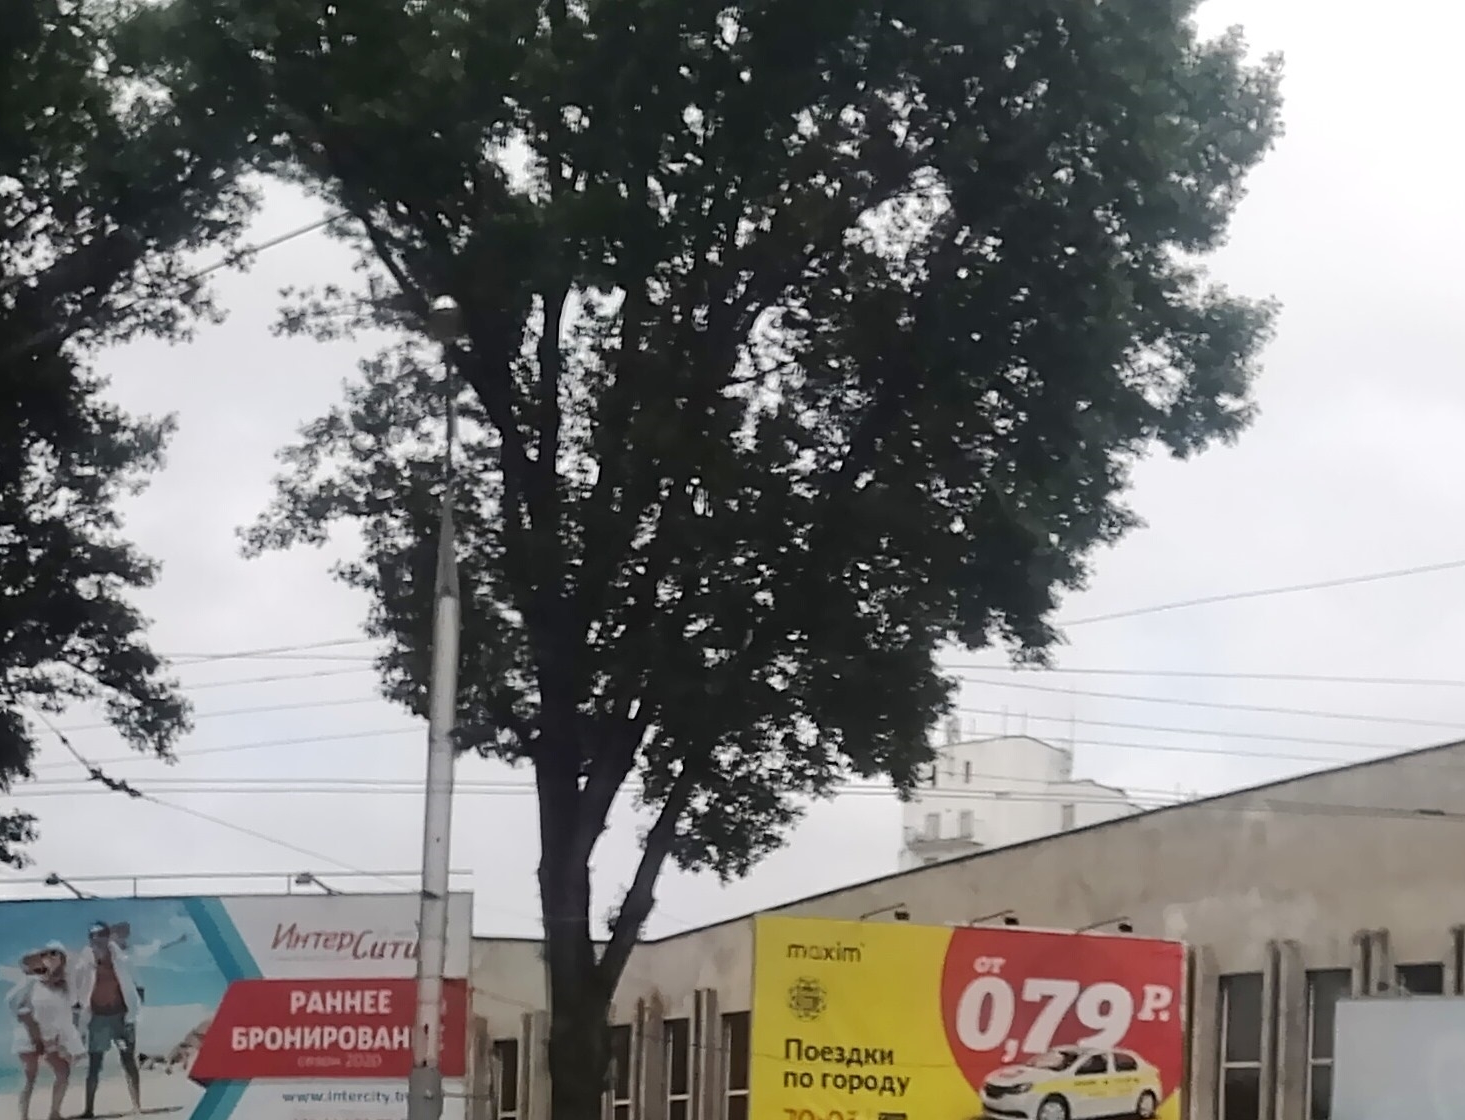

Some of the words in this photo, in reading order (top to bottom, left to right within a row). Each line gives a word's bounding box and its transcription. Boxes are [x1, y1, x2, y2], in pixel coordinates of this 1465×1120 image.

[787, 942, 862, 963] maxim
[290, 988, 393, 1016] РАННЕЕ
[956, 975, 1134, 1063] 0,79
[784, 1038, 894, 1068] Поездки
[783, 1070, 813, 1089] по
[821, 1071, 910, 1097] городу
